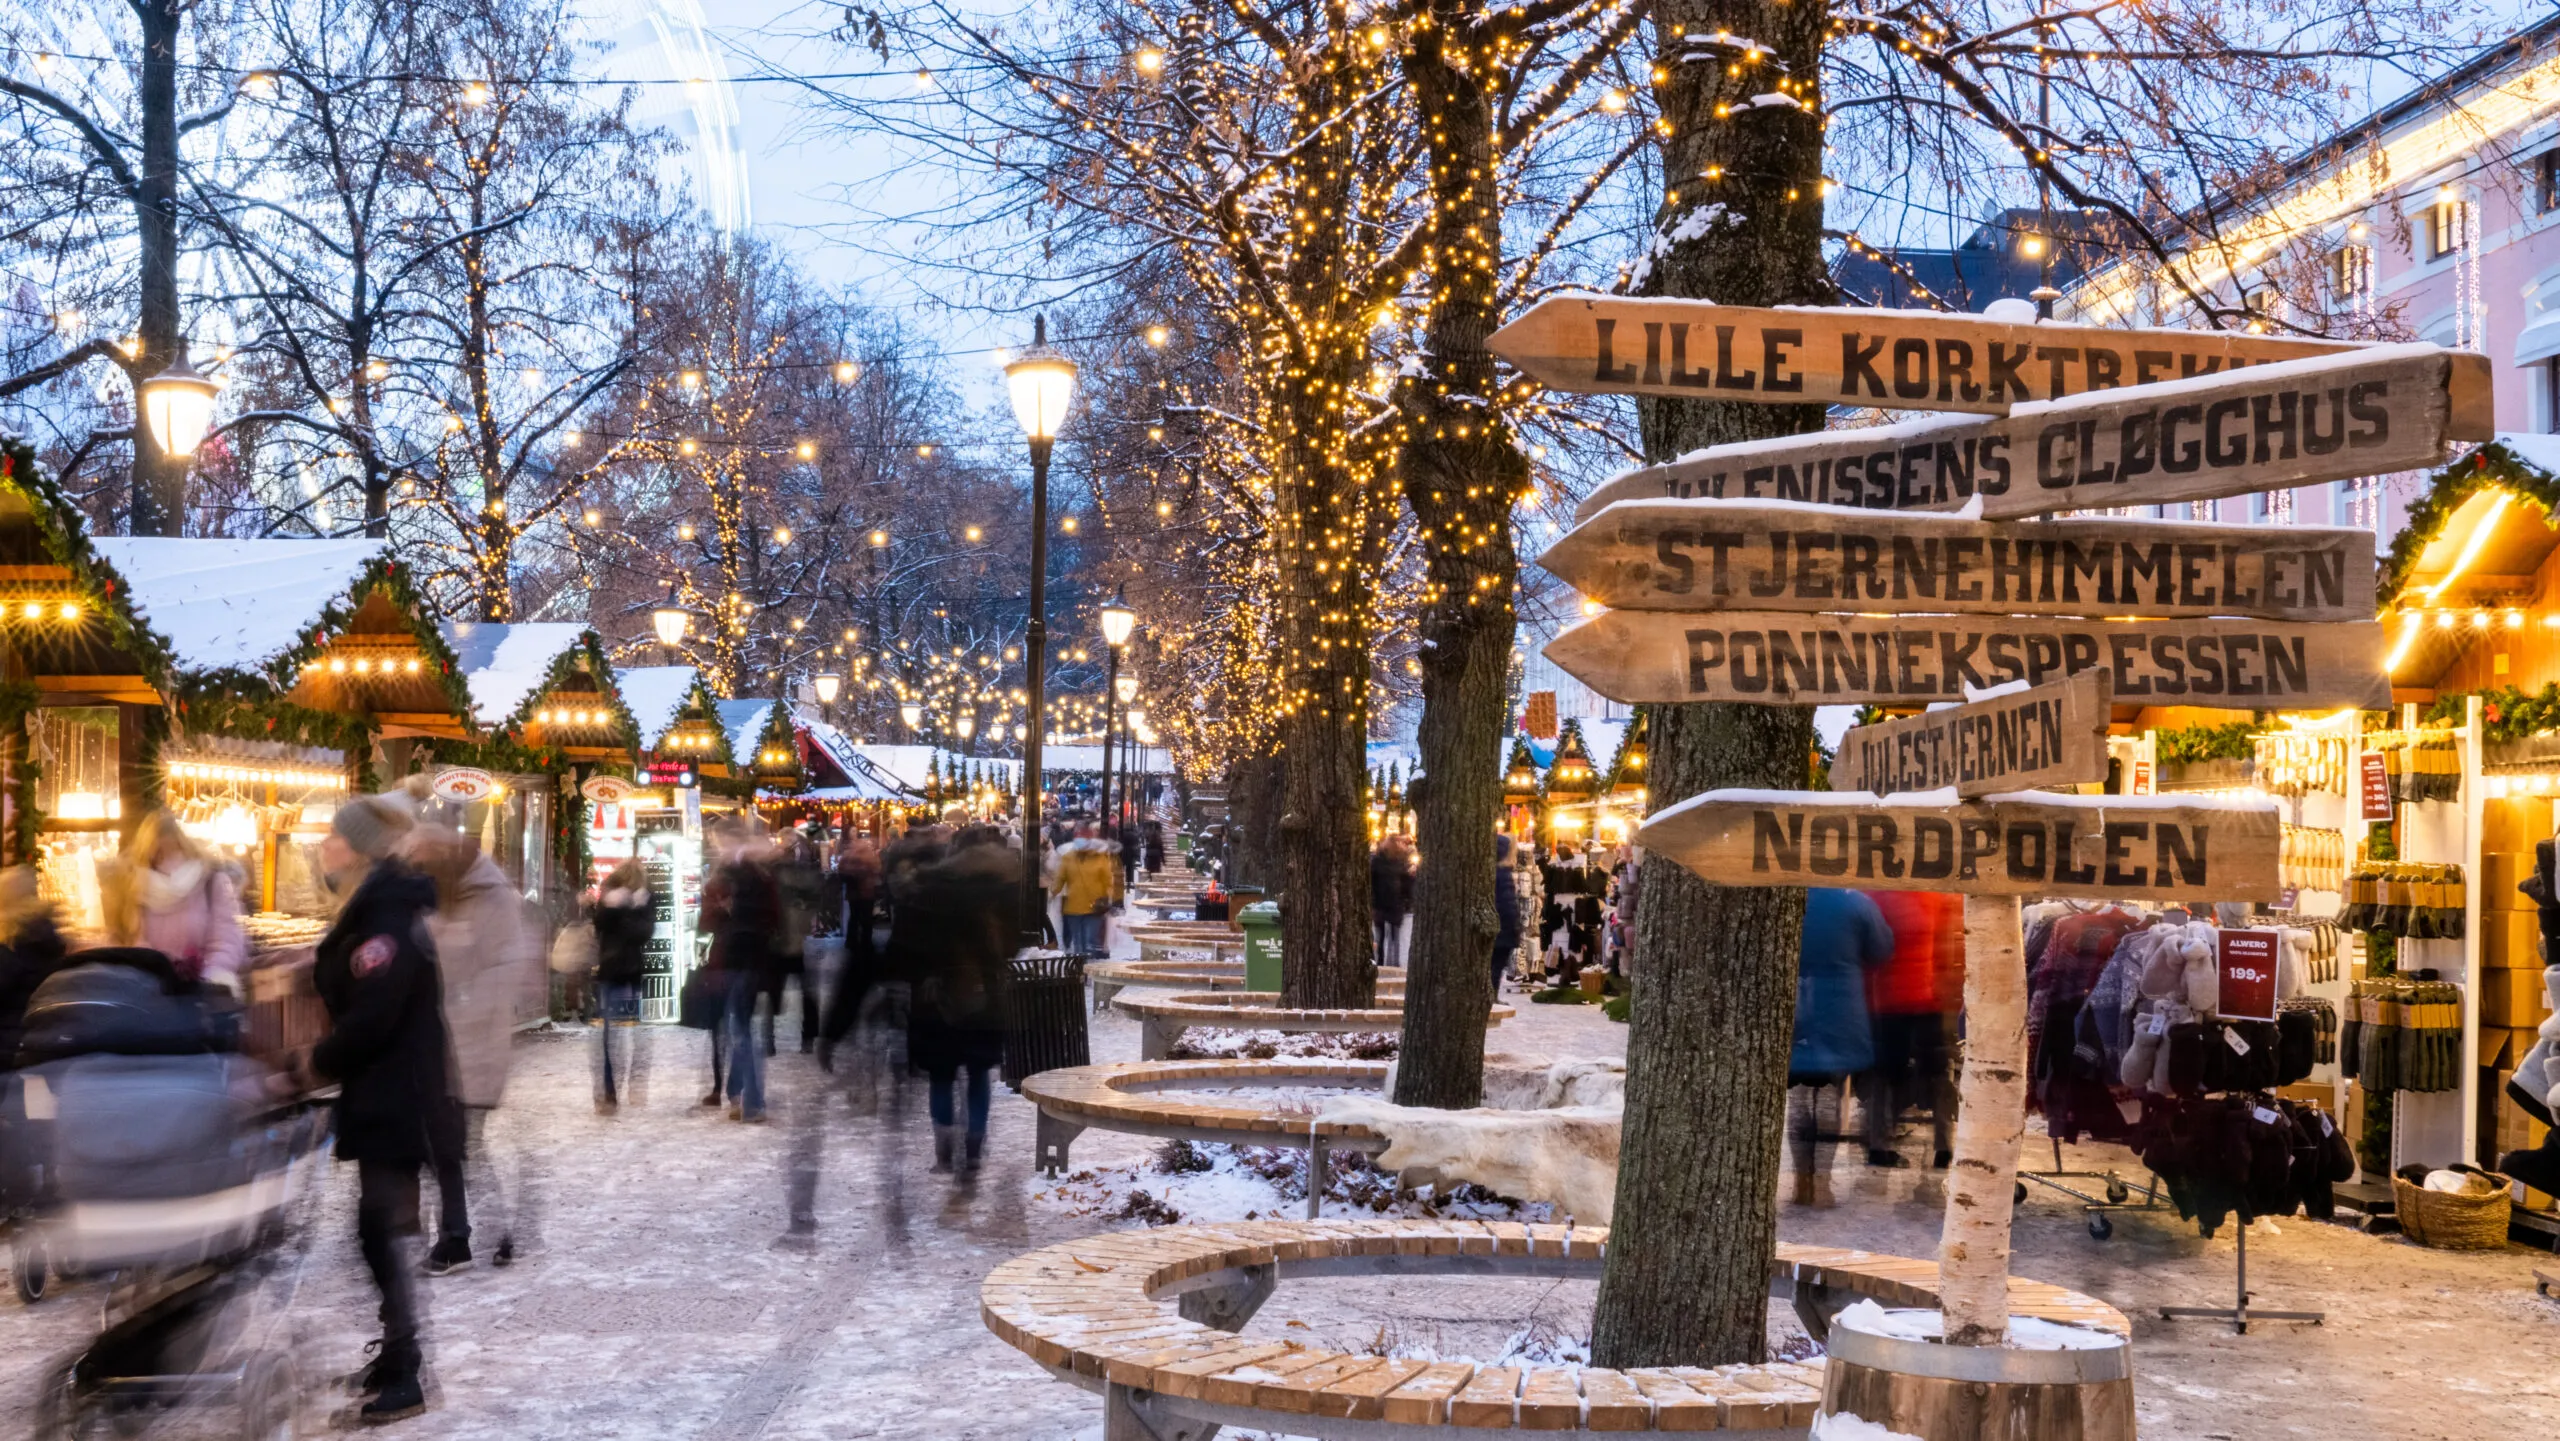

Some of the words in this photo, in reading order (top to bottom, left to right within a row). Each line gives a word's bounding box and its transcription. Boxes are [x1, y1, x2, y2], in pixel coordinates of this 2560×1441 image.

[1596, 319, 1803, 391] LILLE
[2037, 380, 2389, 490] GLØGGHUS
[1655, 531, 2346, 606] STJERNEHIMMELEN
[1857, 699, 2063, 794] JULESTJERNEN
[1752, 811, 2207, 887] NORDPOLEN
[2229, 940, 2268, 949] ALWERO
[2229, 967, 2268, 983] 199,-
